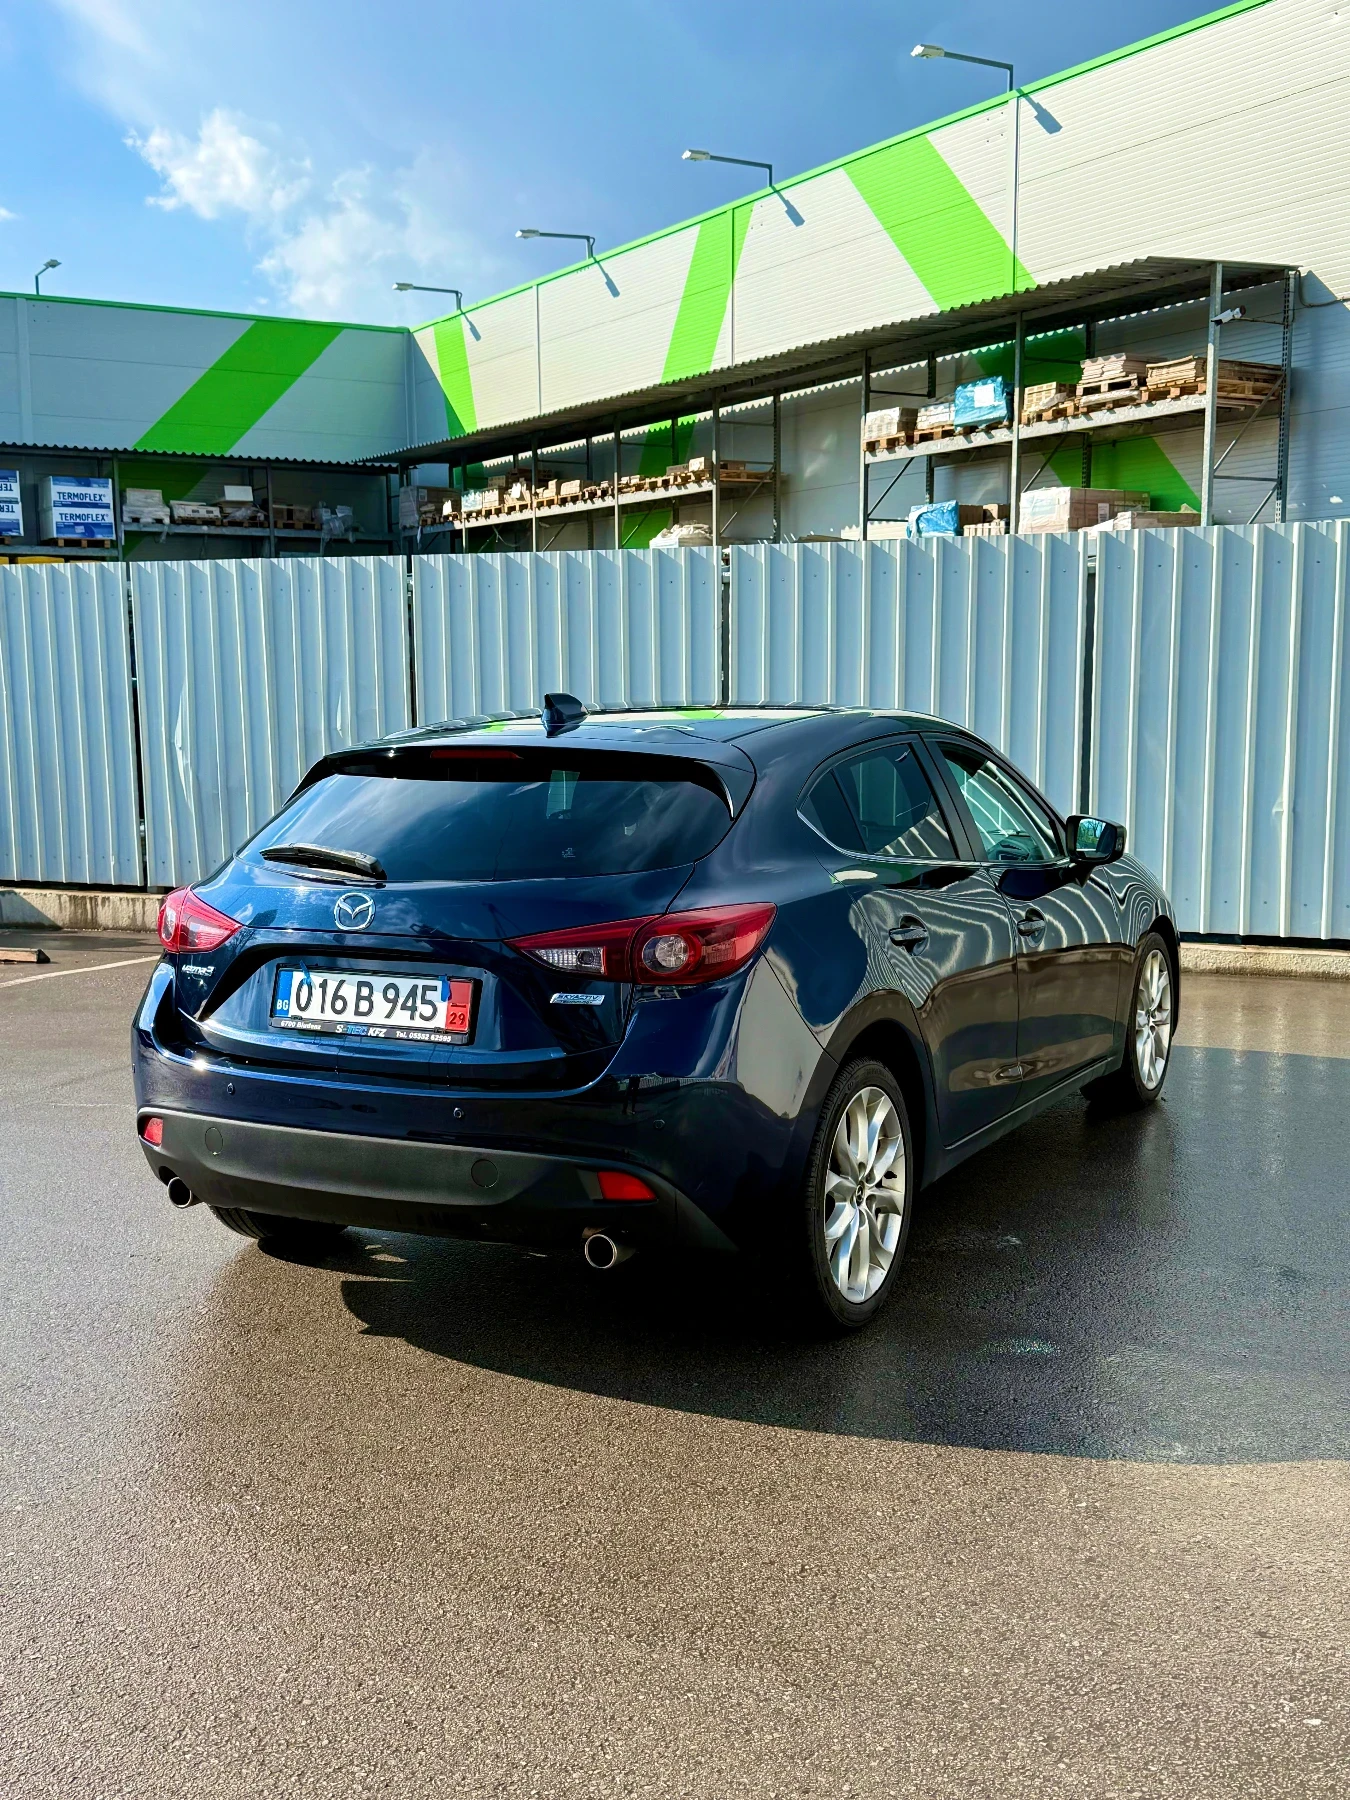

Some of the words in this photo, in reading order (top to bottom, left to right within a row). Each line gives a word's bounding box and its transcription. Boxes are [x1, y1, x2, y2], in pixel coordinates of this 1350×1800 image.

[276, 999, 289, 1011] BG
[449, 1012, 465, 1025] 29
[368, 1027, 387, 1037] KFZ
